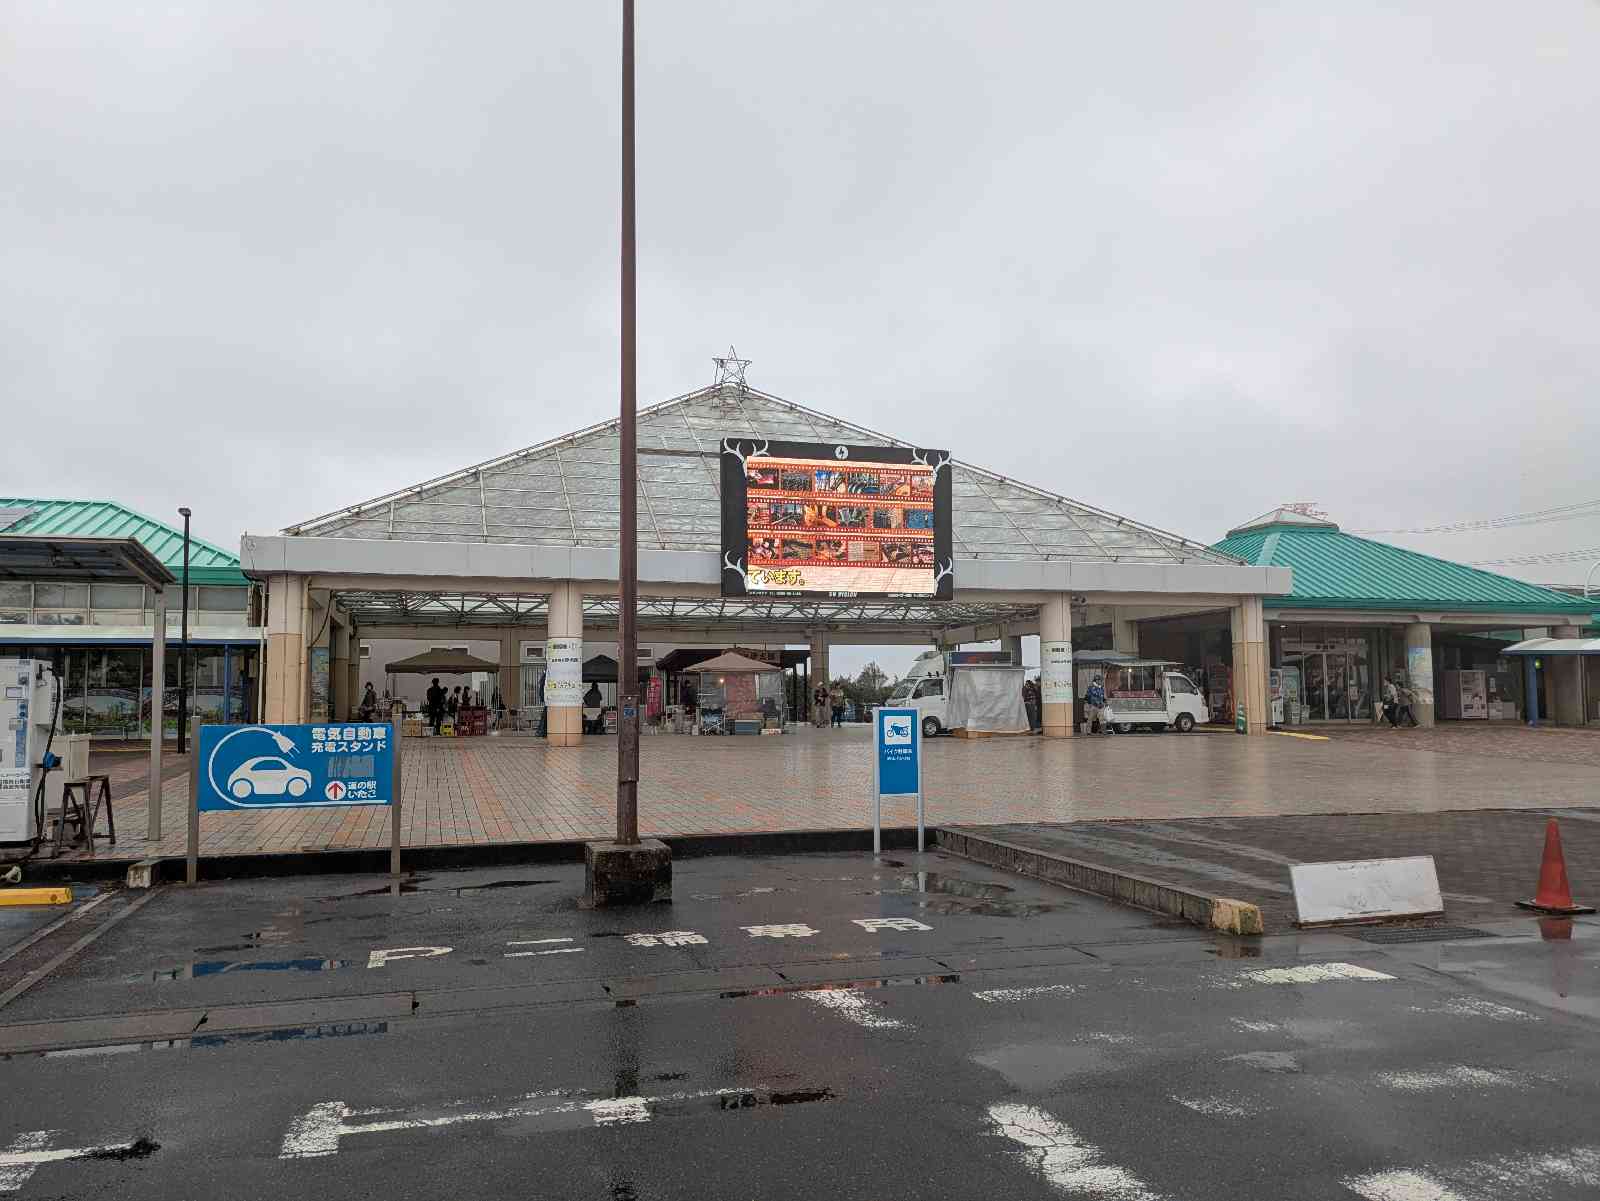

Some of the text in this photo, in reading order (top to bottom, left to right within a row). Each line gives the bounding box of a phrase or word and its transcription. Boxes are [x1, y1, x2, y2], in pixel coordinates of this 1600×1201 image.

[748, 569, 806, 586] ています。
[312, 727, 386, 740] 電気自動車
[312, 741, 386, 752] 充電スタンド
[347, 780, 377, 790] 道の駅
[347, 789, 377, 799] いたこ
